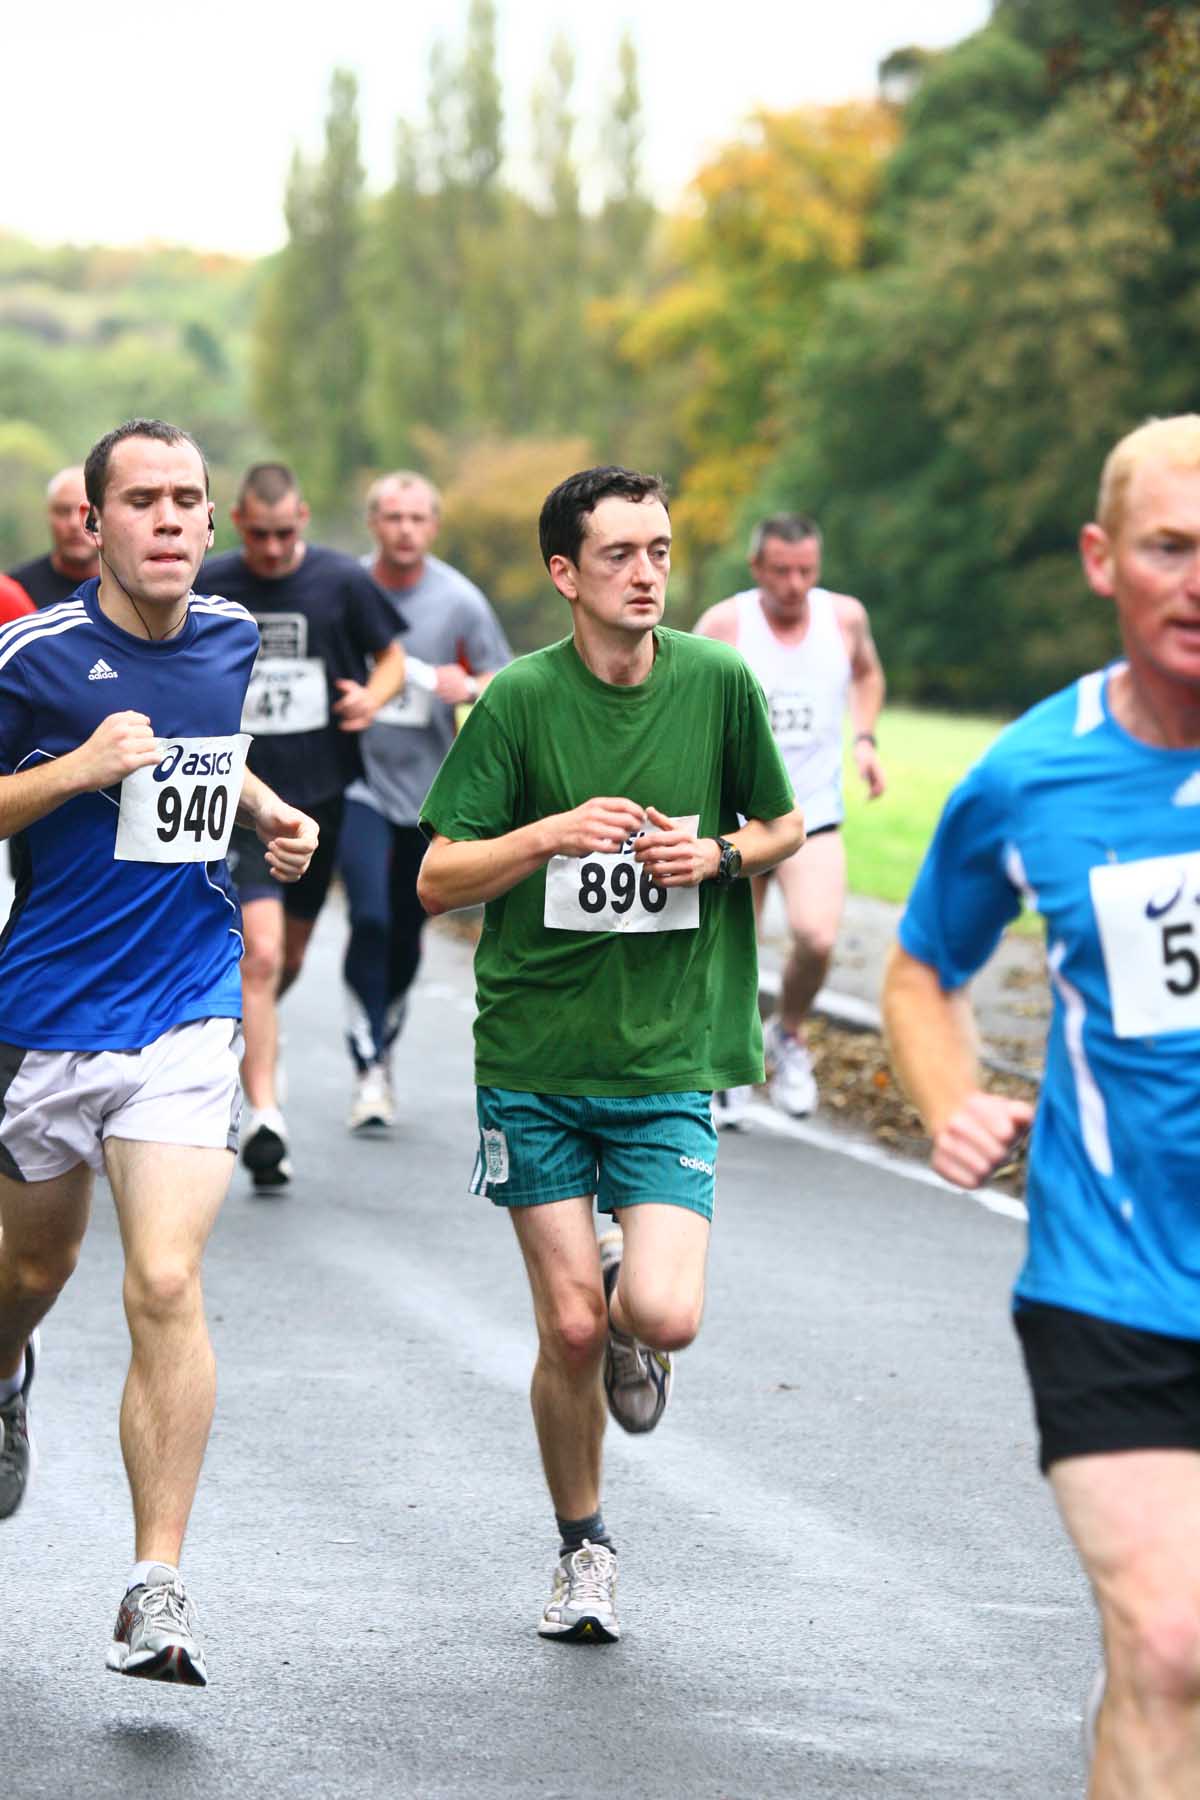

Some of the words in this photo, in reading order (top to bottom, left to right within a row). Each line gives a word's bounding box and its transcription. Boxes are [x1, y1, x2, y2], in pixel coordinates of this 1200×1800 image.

[88, 671, 118, 680] adidas
[181, 751, 233, 776] asics
[157, 785, 228, 843] 940
[578, 862, 667, 913] 896
